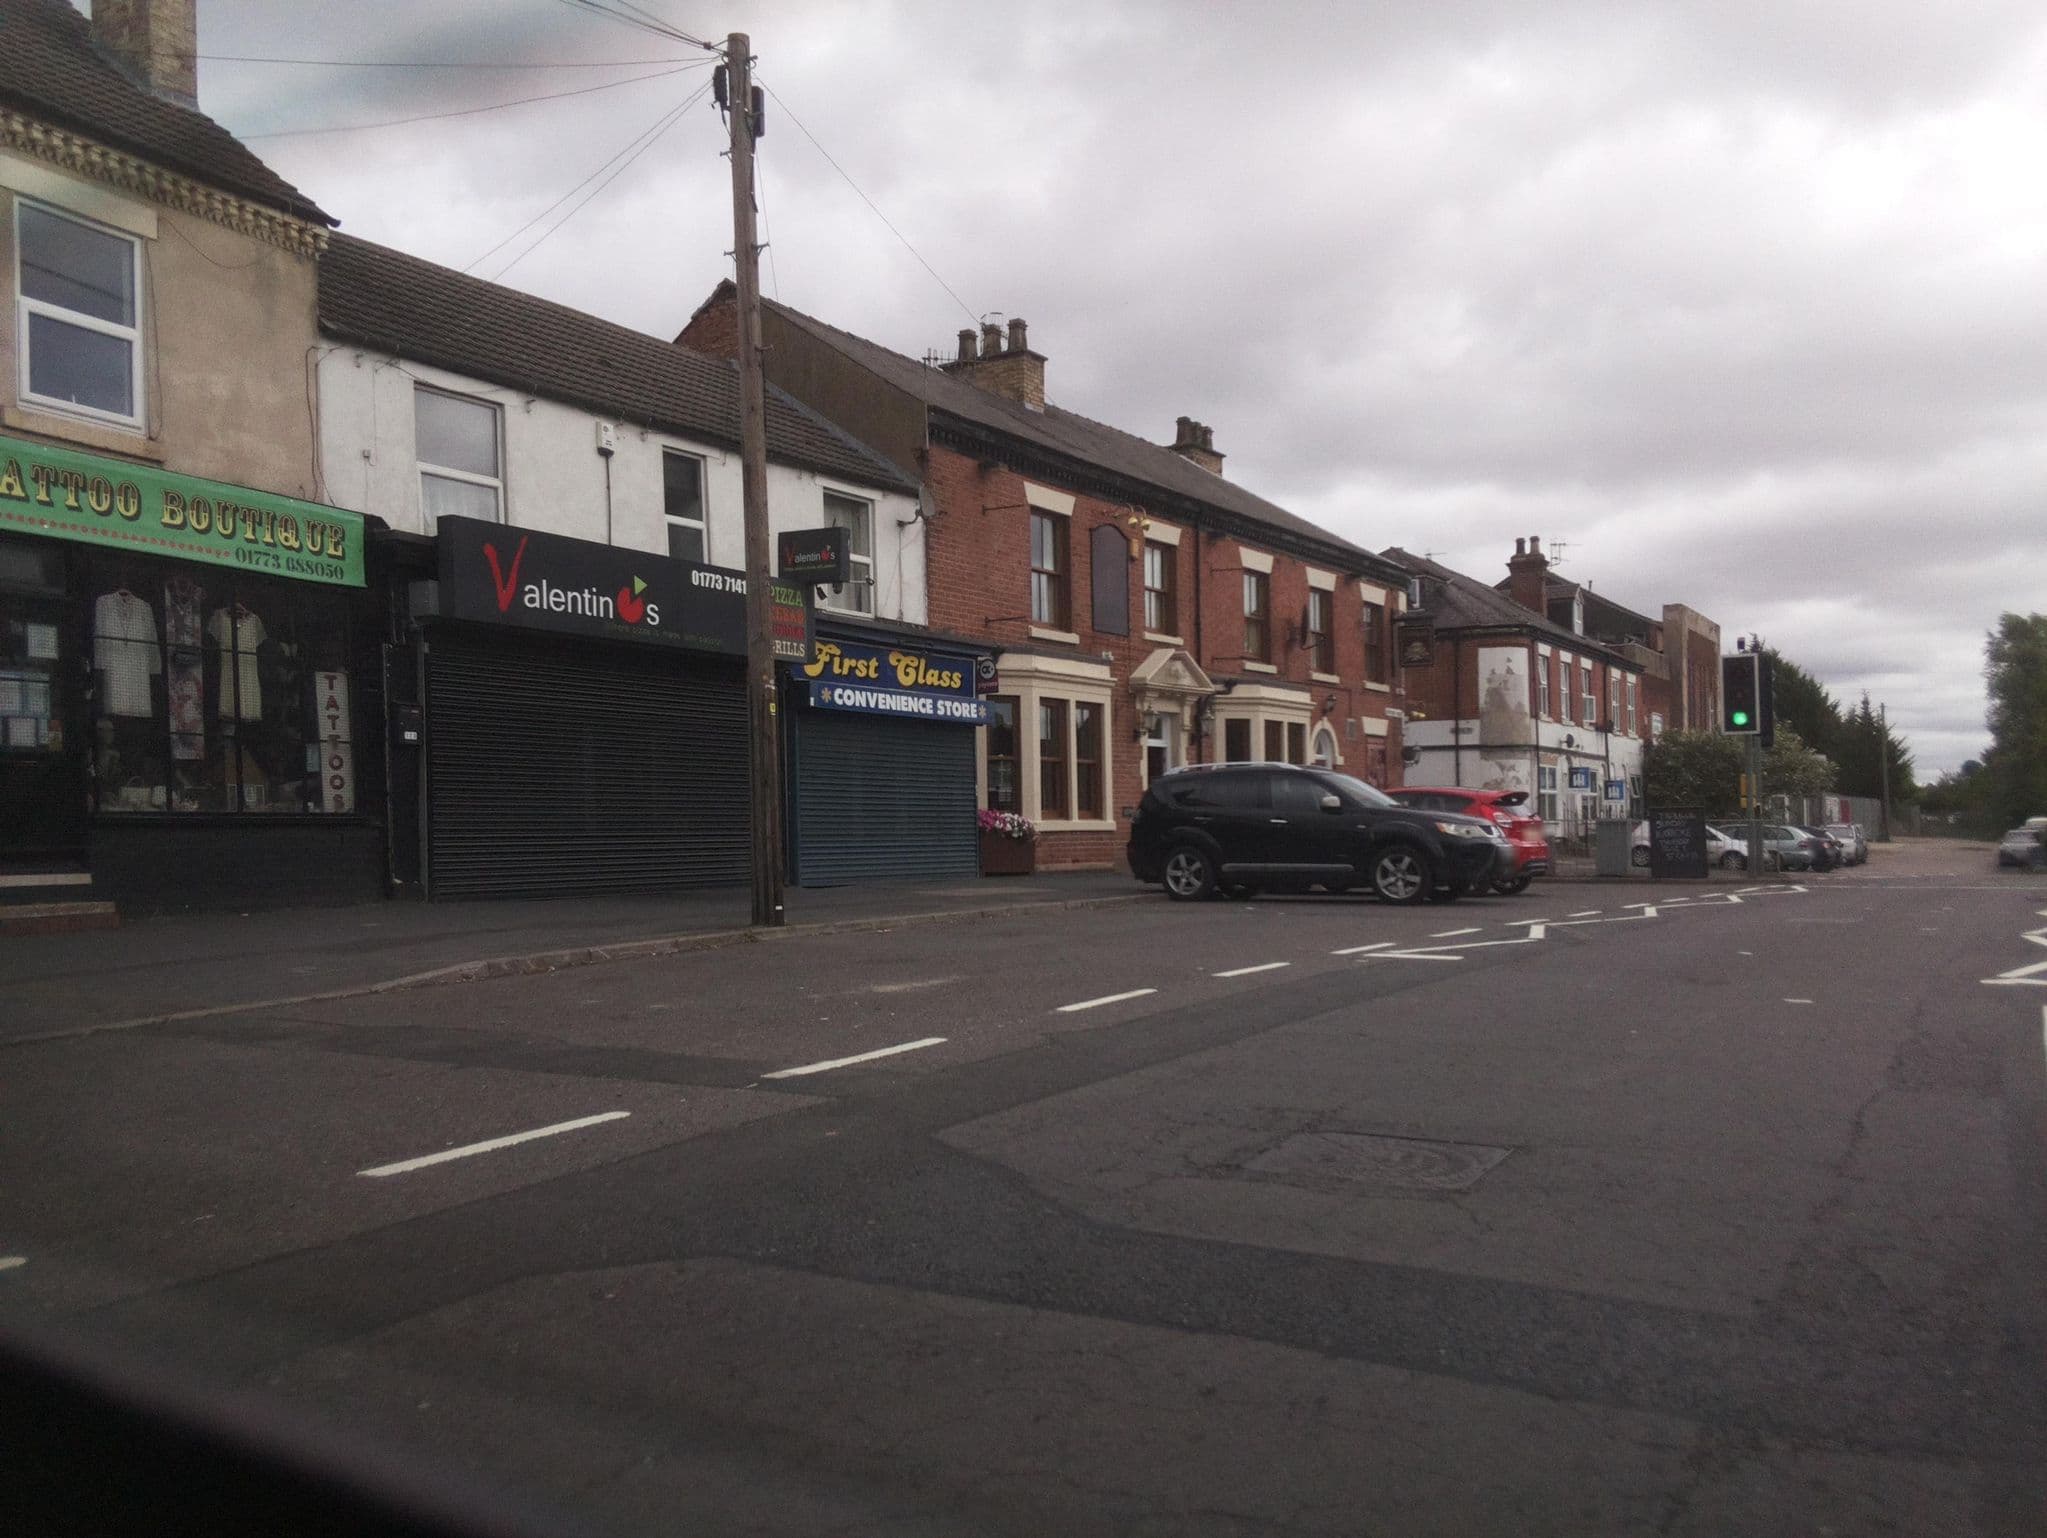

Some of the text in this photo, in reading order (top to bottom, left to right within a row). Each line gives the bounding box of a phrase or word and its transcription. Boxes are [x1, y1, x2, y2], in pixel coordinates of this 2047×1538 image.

[160, 488, 346, 560] BOUTIQUE
[235, 547, 345, 580] 01773 688050
[691, 569, 747, 595] 01773 7141
[772, 641, 806, 657] RILLS
[804, 641, 963, 690] First Class
[833, 688, 978, 719] CONVENIENCE STORE
